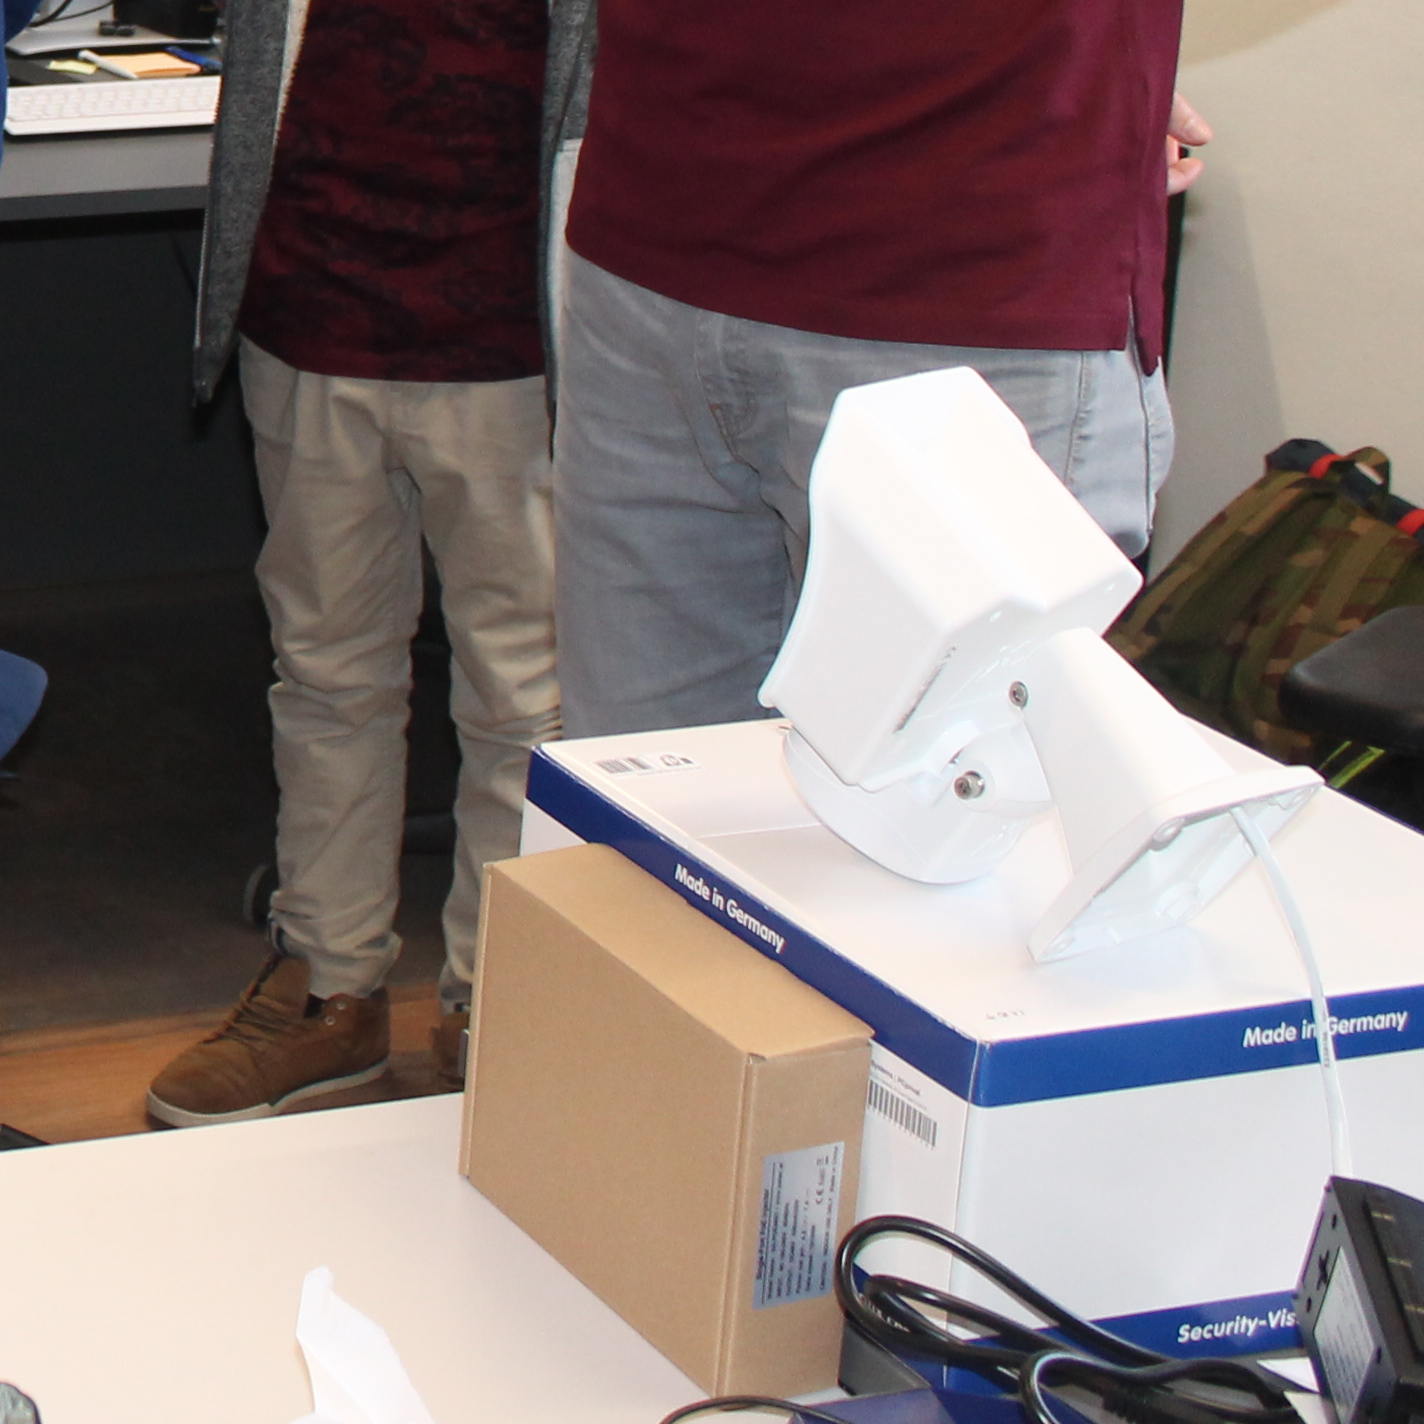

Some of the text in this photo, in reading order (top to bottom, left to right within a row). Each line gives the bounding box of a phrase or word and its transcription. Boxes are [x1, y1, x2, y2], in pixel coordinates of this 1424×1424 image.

[674, 863, 786, 954] Made in Germany
[1242, 1022, 1297, 1048] Made
[1301, 1019, 1318, 1040] in
[1326, 1010, 1409, 1037] Germany
[1177, 1308, 1300, 1343] Security-Vis
